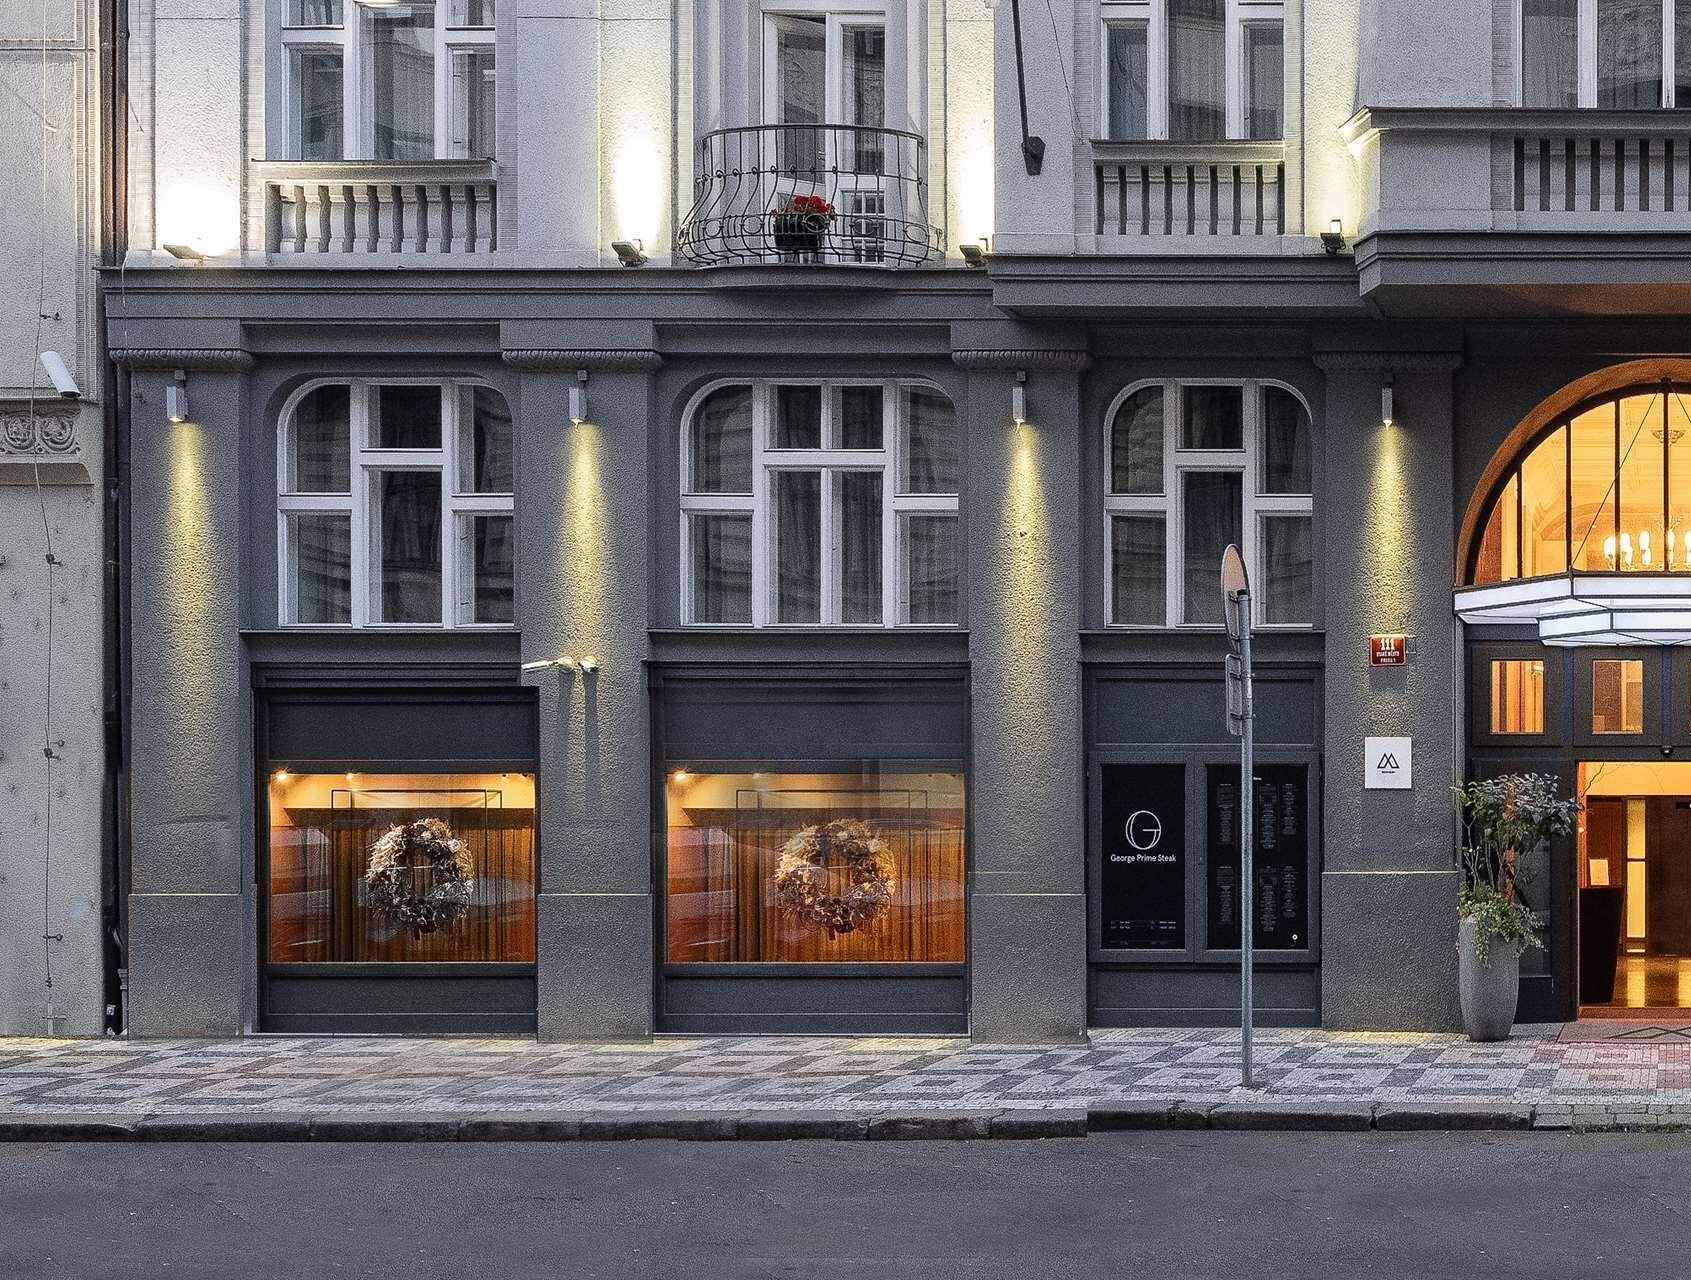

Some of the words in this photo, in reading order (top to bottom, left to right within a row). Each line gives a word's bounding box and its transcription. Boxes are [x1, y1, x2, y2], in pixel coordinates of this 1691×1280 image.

[1110, 853, 1136, 864] George
[1136, 853, 1156, 862] Prime
[1157, 853, 1177, 862] Steak
